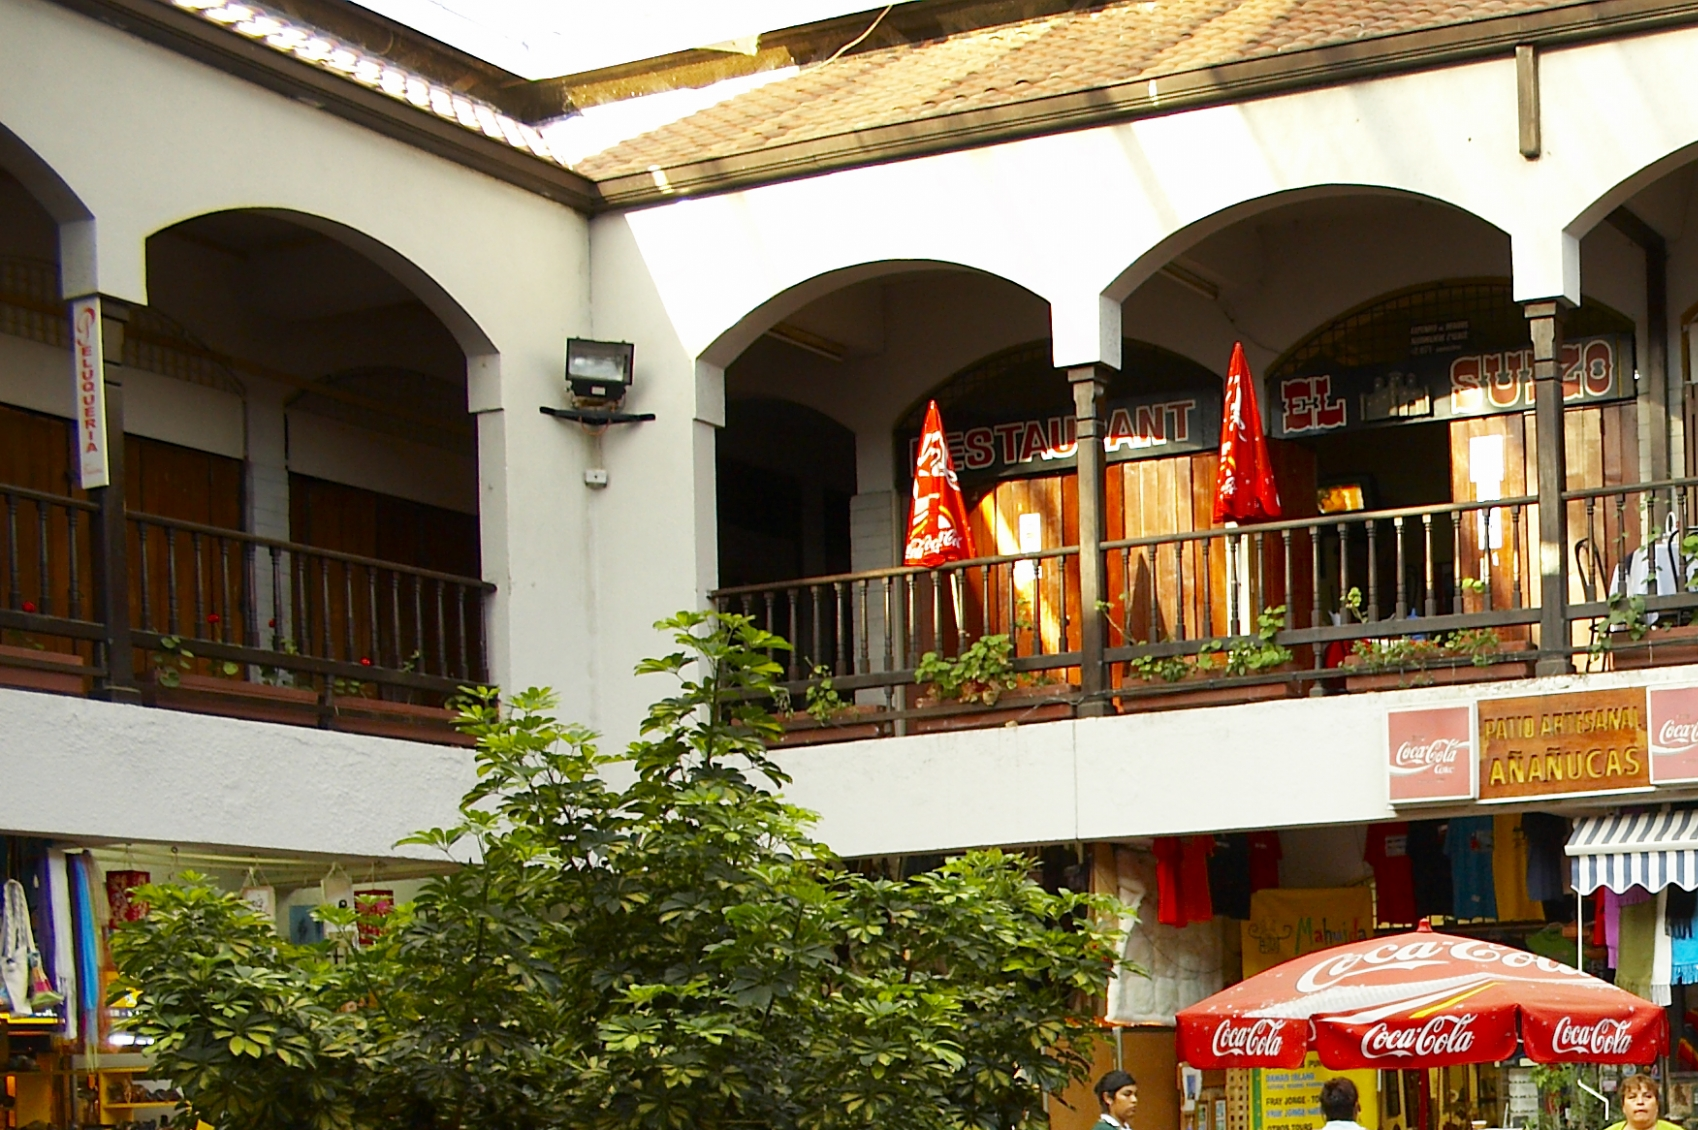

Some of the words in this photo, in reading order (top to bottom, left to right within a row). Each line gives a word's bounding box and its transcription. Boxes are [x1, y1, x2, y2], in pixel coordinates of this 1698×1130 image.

[1281, 375, 1348, 434] EL
[1451, 339, 1614, 415] SUZO
[909, 400, 1196, 477] ESTAUANT
[1484, 715, 1535, 741] PATIO
[1540, 706, 1641, 737] ARTESANAL
[1396, 738, 1459, 766] Coca-Cola
[1489, 746, 1641, 786] AÑAÑUCAS
[1212, 1017, 1286, 1057] Coca-Cola
[1361, 1013, 1478, 1060] Coca-Cola
[1552, 1016, 1633, 1058] Coca-Cola
